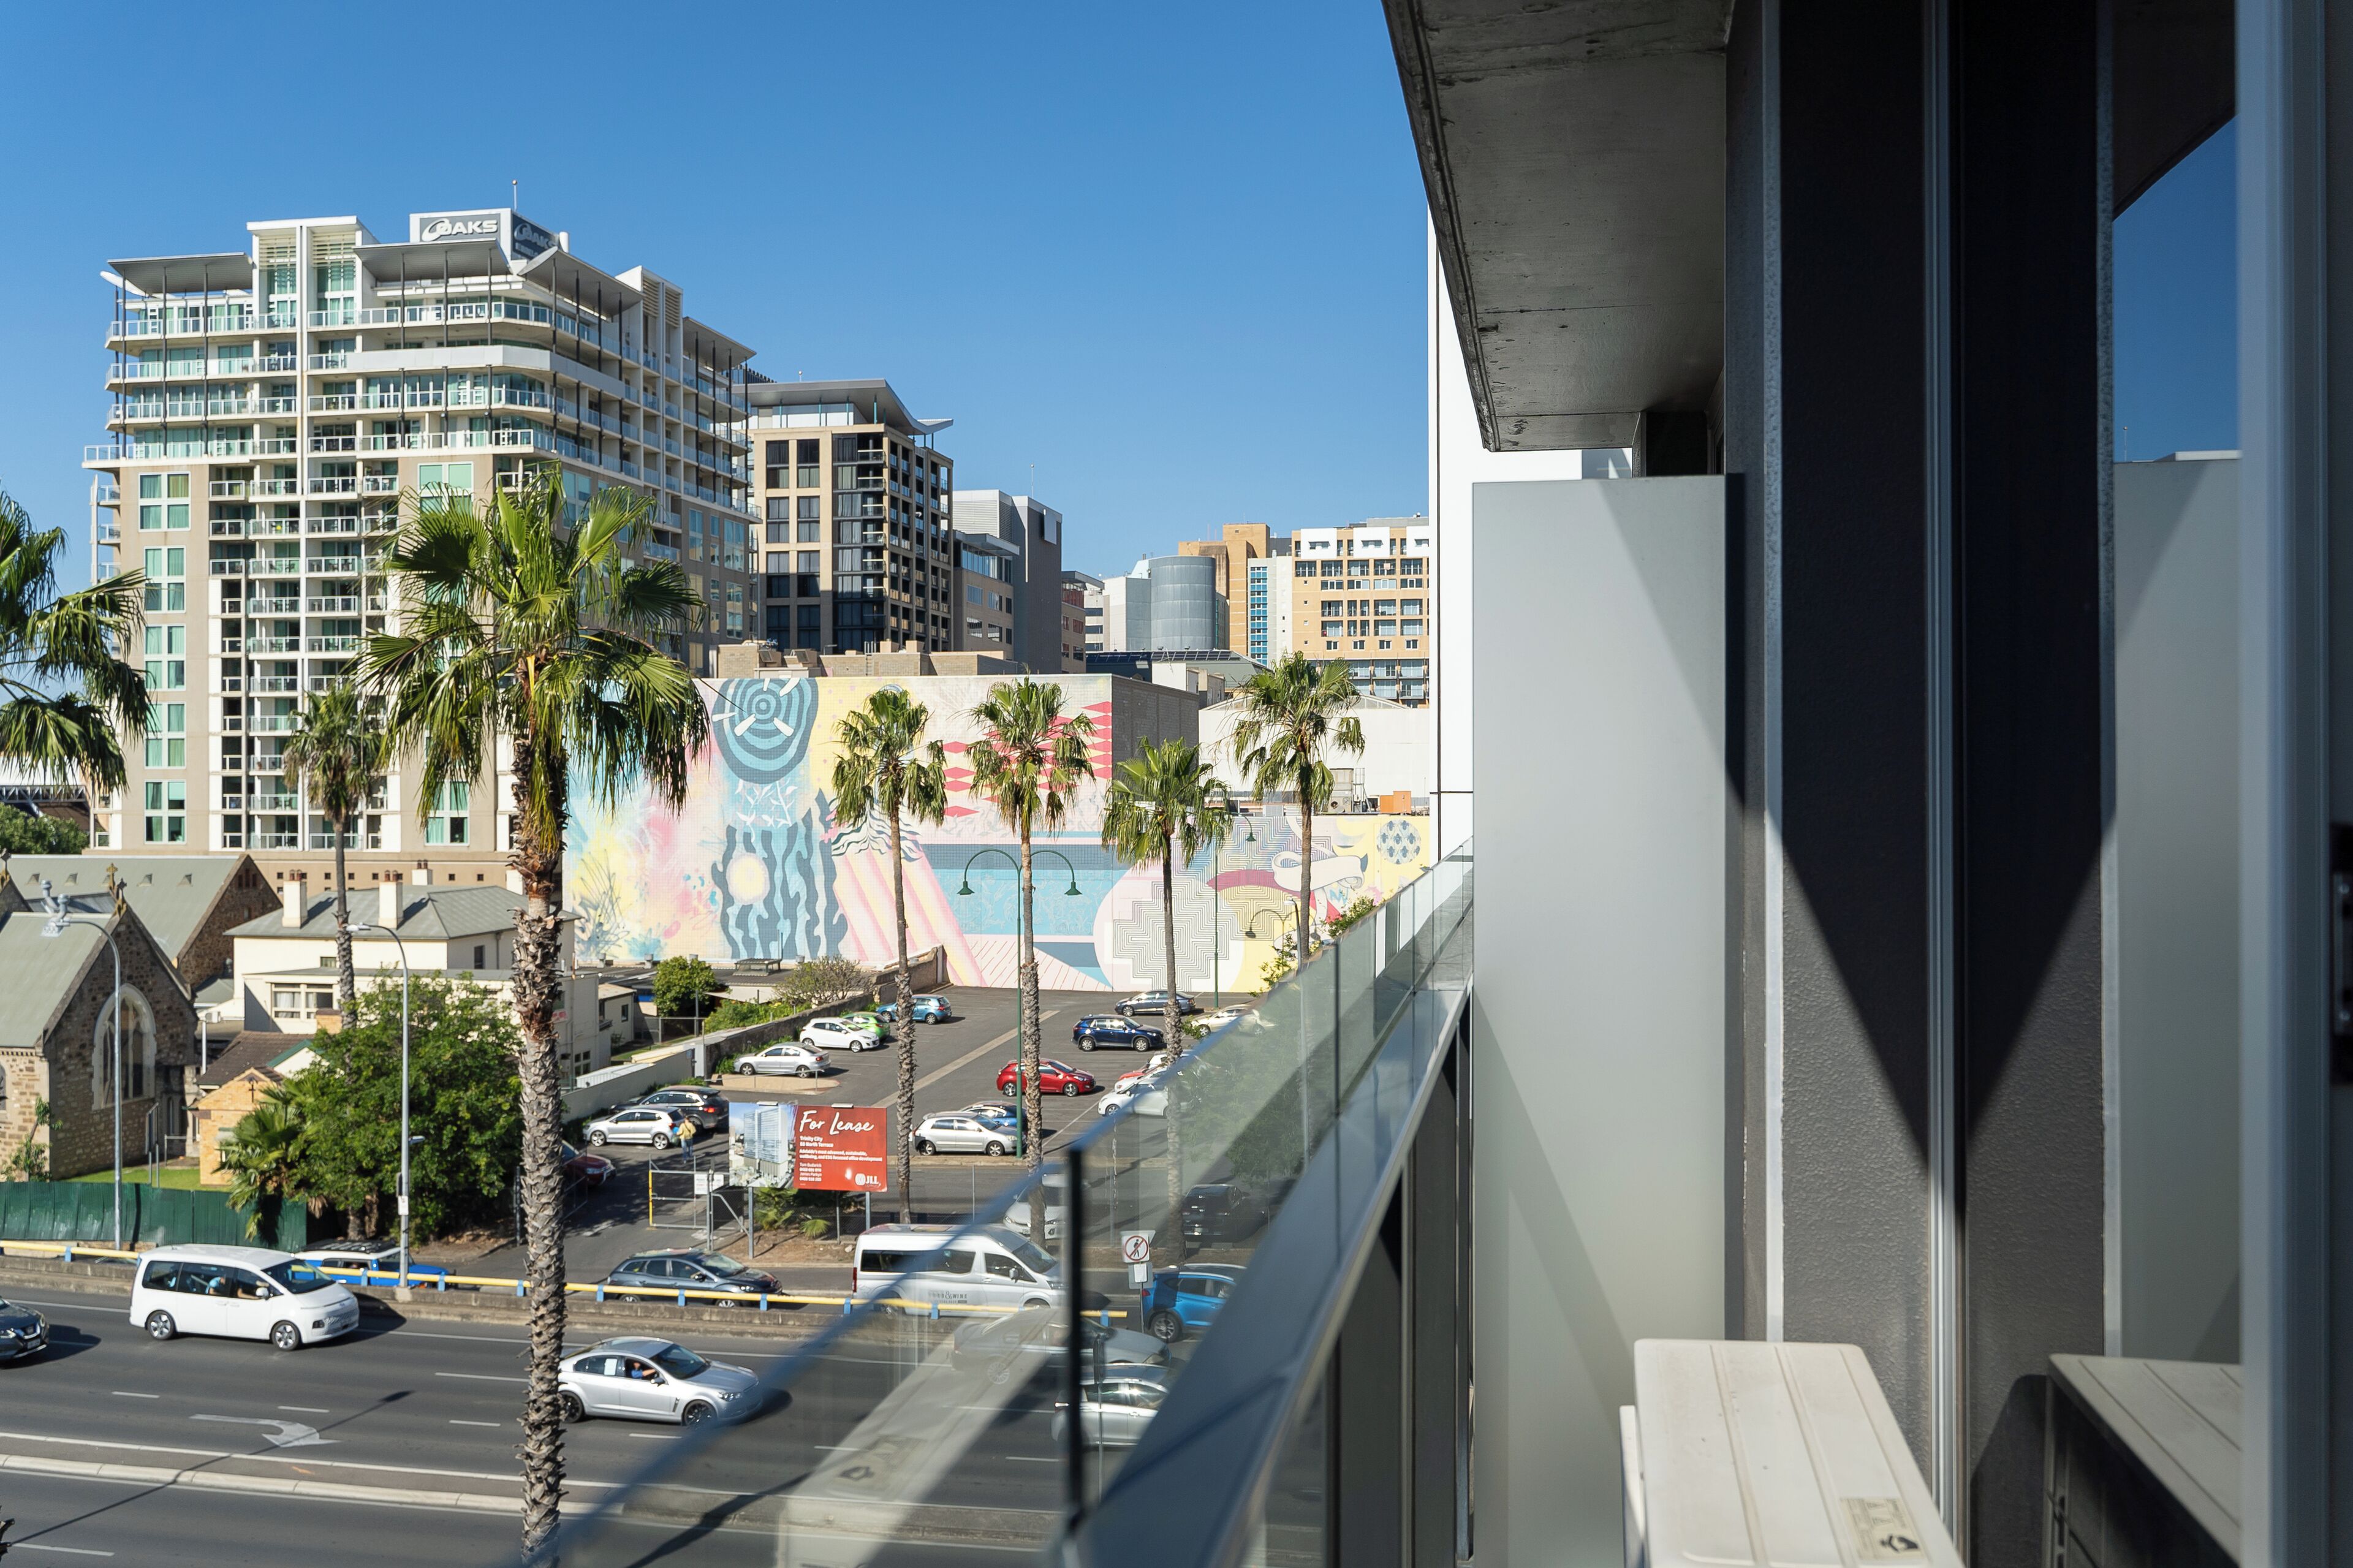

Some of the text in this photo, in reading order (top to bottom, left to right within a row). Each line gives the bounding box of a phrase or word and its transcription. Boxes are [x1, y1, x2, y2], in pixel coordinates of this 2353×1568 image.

[422, 218, 498, 241] OAKS
[799, 1110, 874, 1135] For Lease
[866, 1175, 879, 1184] JLL
